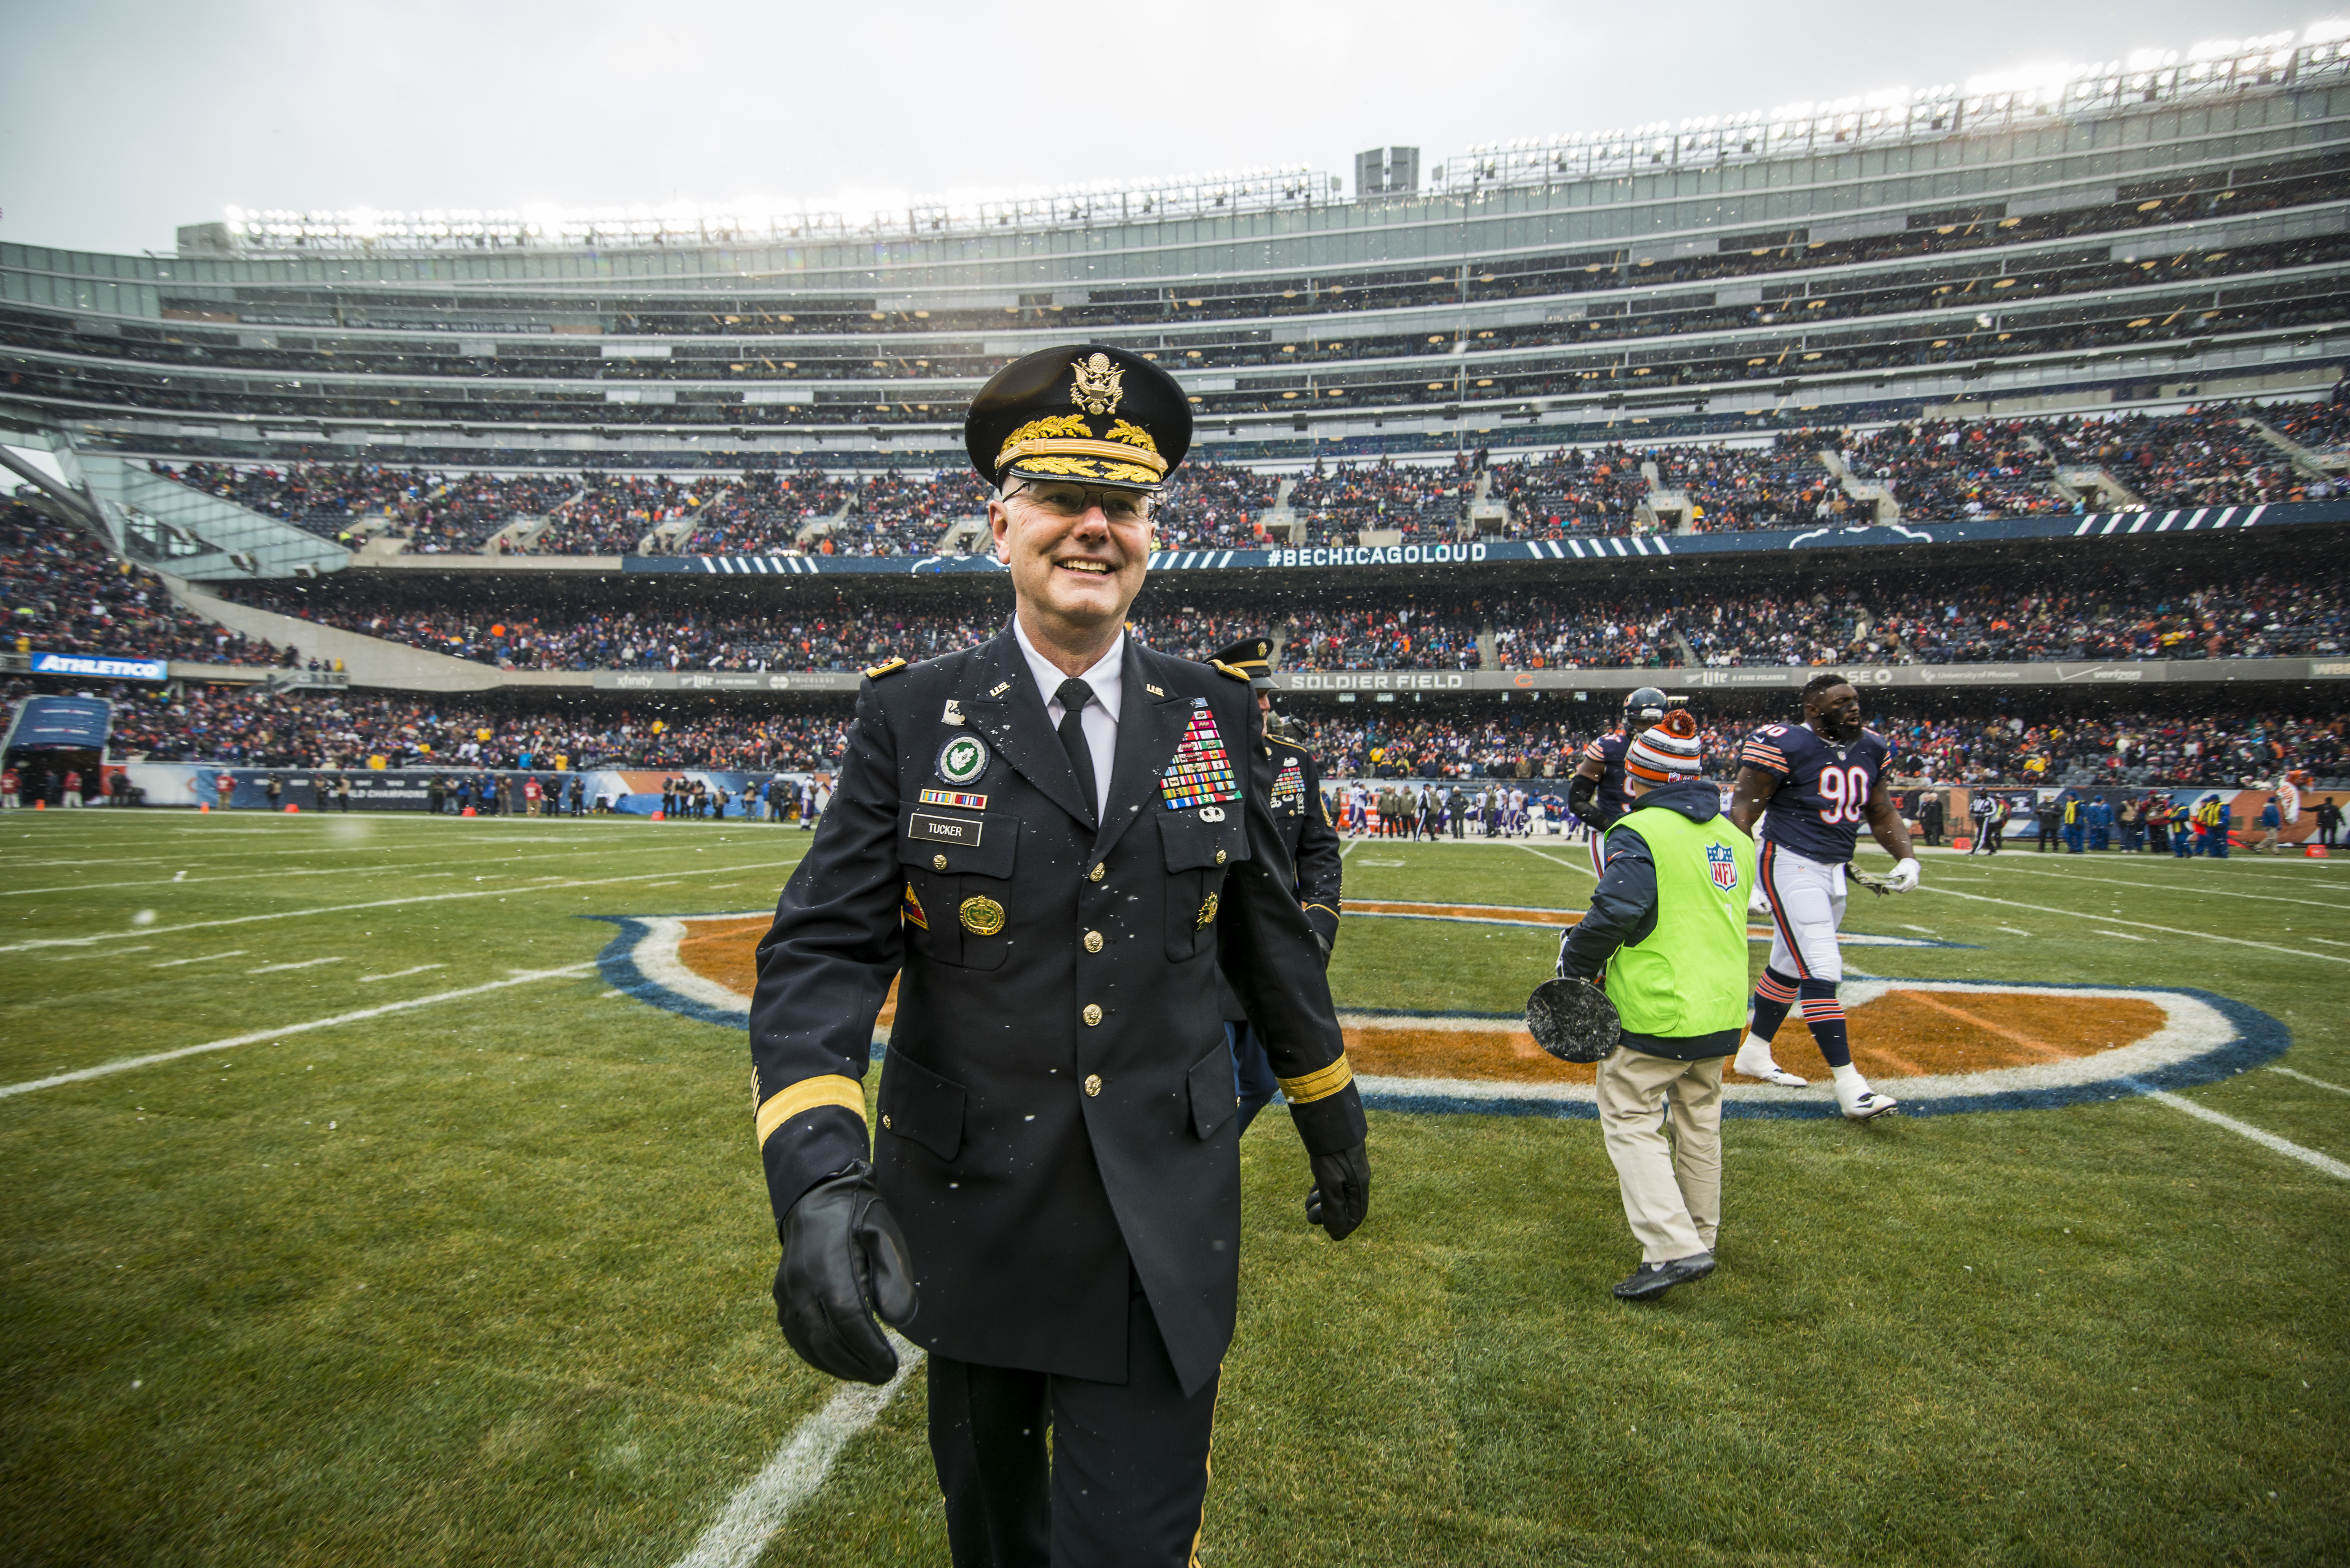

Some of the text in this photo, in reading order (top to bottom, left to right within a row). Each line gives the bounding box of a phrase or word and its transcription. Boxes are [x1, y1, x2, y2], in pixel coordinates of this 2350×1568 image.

[1268, 543, 1486, 567] #BECHICAGOLOUD
[39, 655, 159, 677] ATHLETICO
[617, 675, 654, 688] xfinity
[1291, 674, 1462, 689] SOLDIER FIELD
[1703, 671, 1728, 686] Lite
[1937, 671, 1977, 681] University
[1987, 670, 2020, 679] Phoenix
[2093, 668, 2143, 681] verizon
[989, 682, 1011, 696] U.S.
[1146, 683, 1165, 697] U.S.
[1819, 765, 1869, 825] 90
[928, 823, 962, 837] TUCKER
[1712, 863, 1735, 886] NFL
